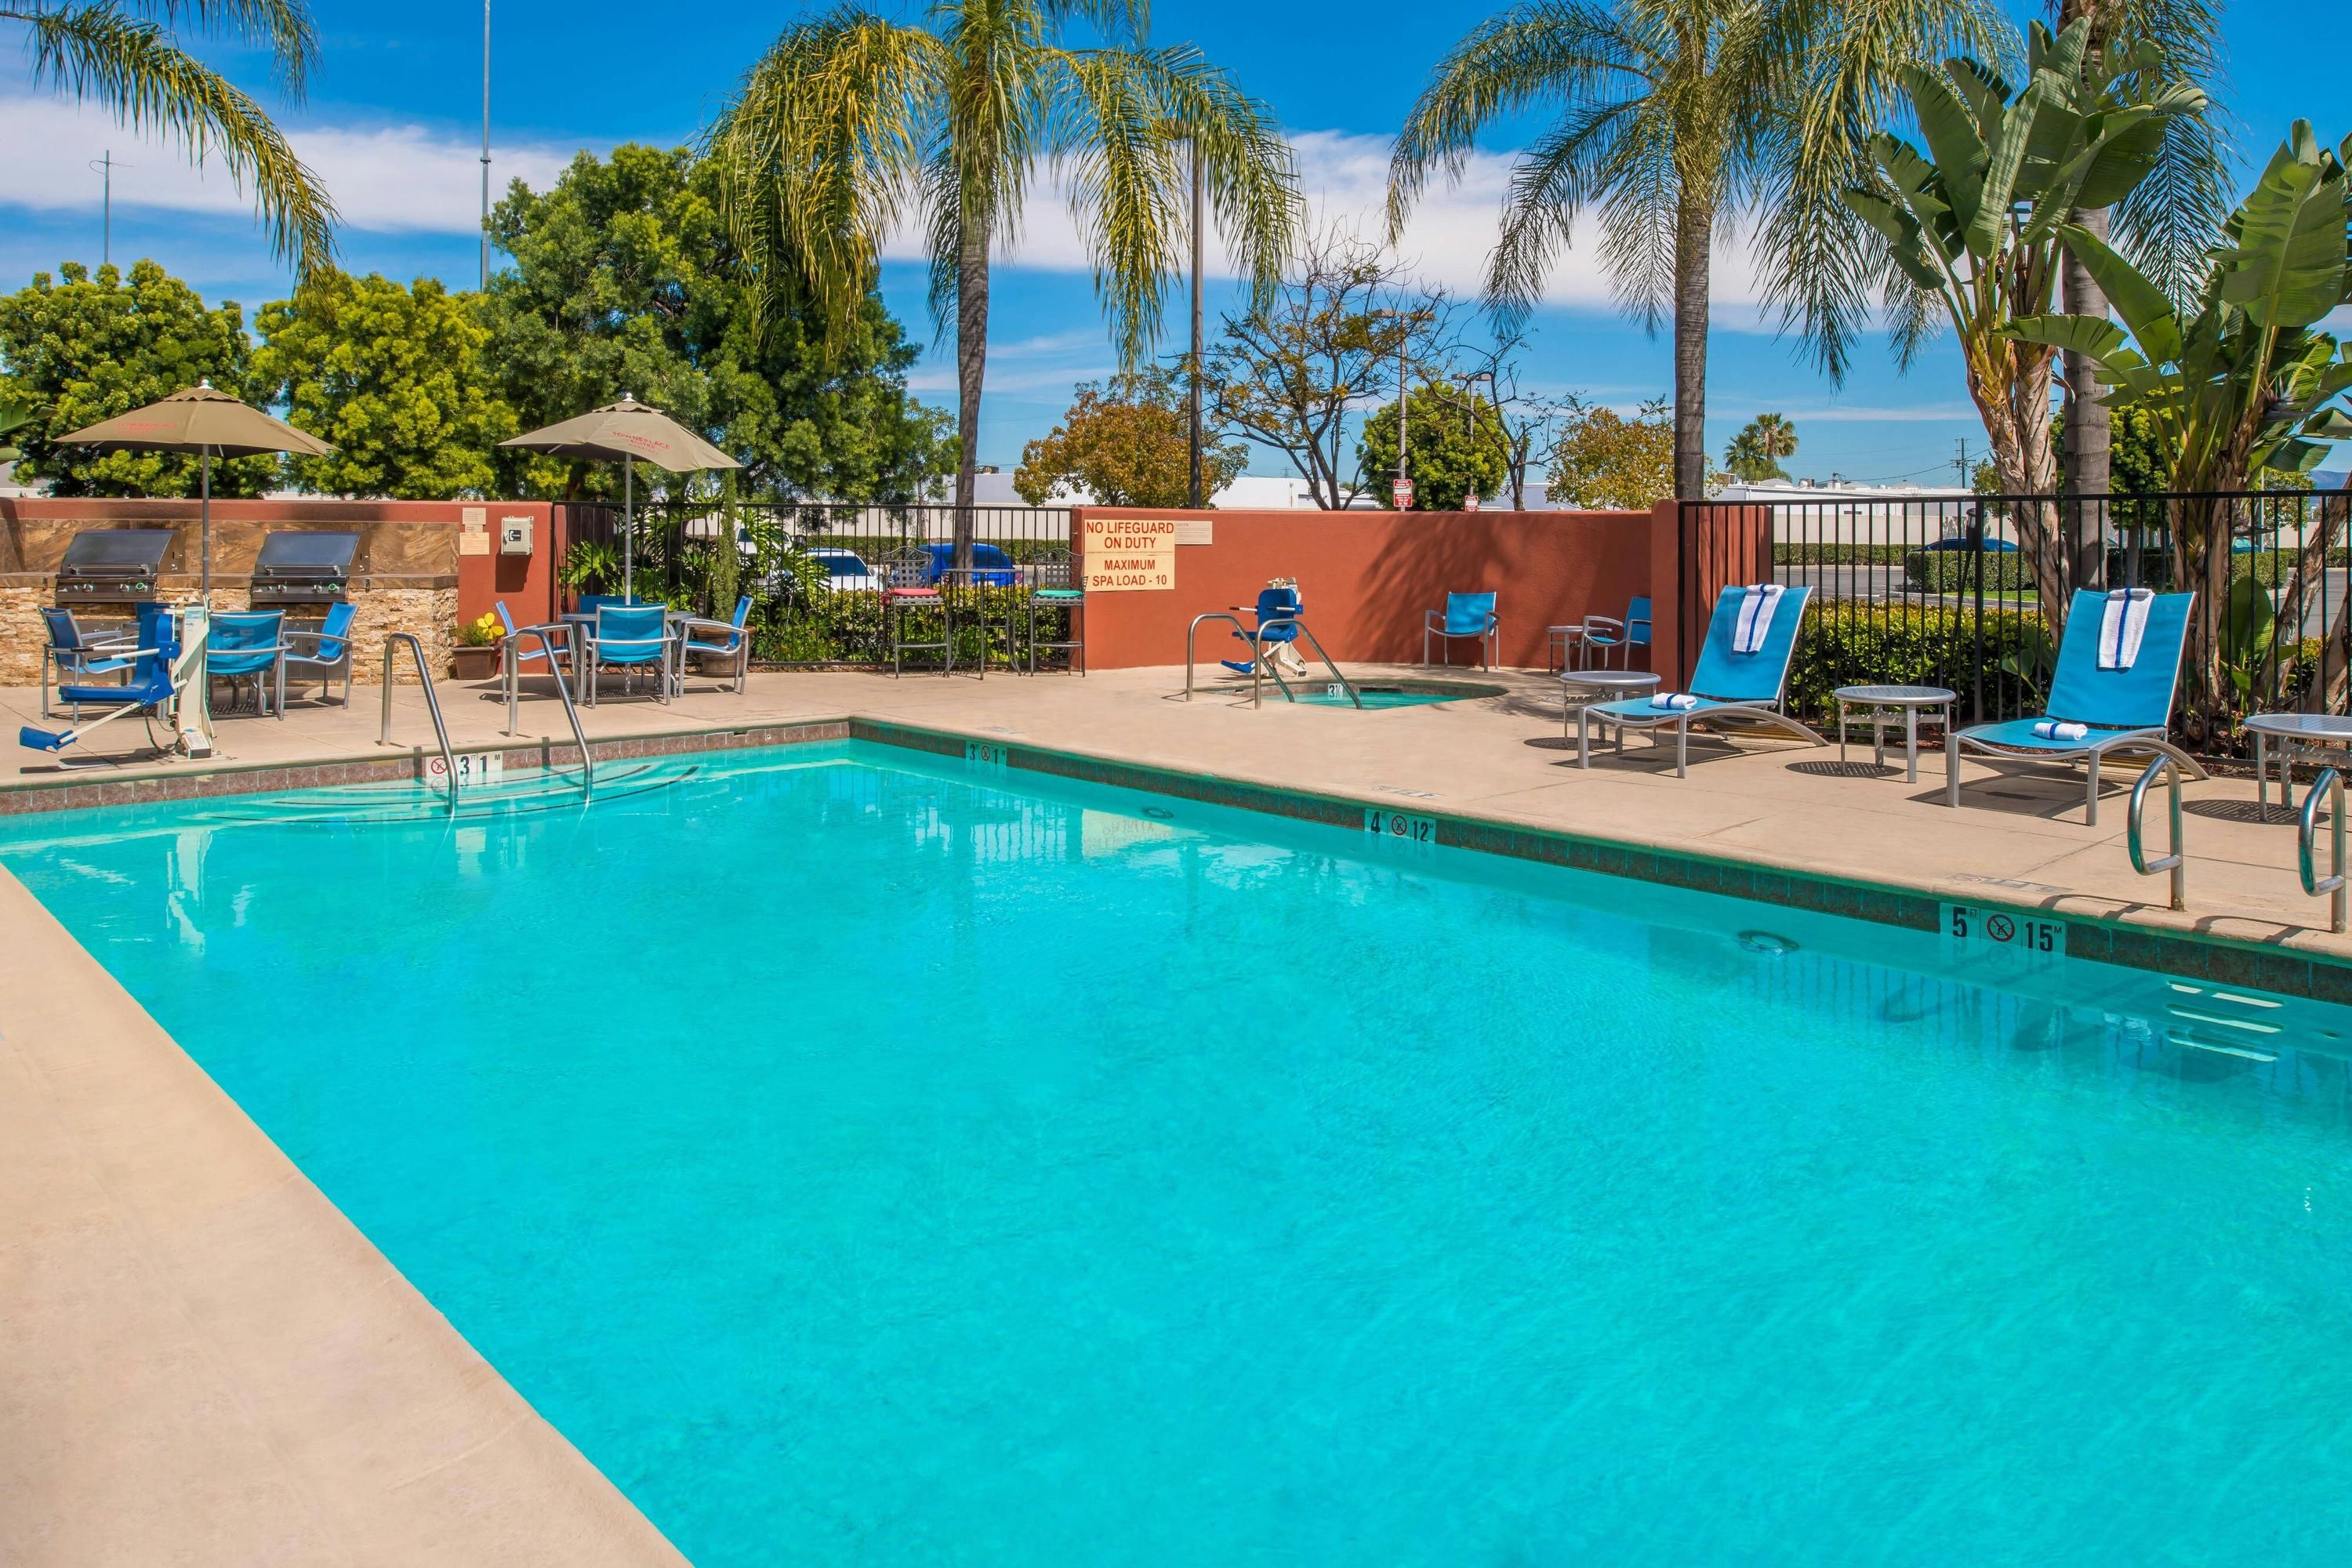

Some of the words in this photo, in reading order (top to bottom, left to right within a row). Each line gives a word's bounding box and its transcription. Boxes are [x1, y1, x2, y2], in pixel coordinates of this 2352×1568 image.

[1087, 521, 1103, 533] NO
[1107, 521, 1174, 534] LIFEGUARD
[1104, 537, 1121, 549] ON
[1125, 537, 1156, 549] DUTY
[1104, 559, 1156, 571] MAXIMUM
[1092, 575, 1114, 586] SPA
[1116, 575, 1146, 586] LOAD
[1156, 574, 1167, 585] 10
[969, 743, 975, 760] 3
[993, 749, 998, 764] 1
[459, 755, 470, 775] 3
[480, 755, 487, 772] 1
[1370, 811, 1381, 833] 4
[1952, 906, 1967, 938] 5
[2054, 925, 2062, 935] M
